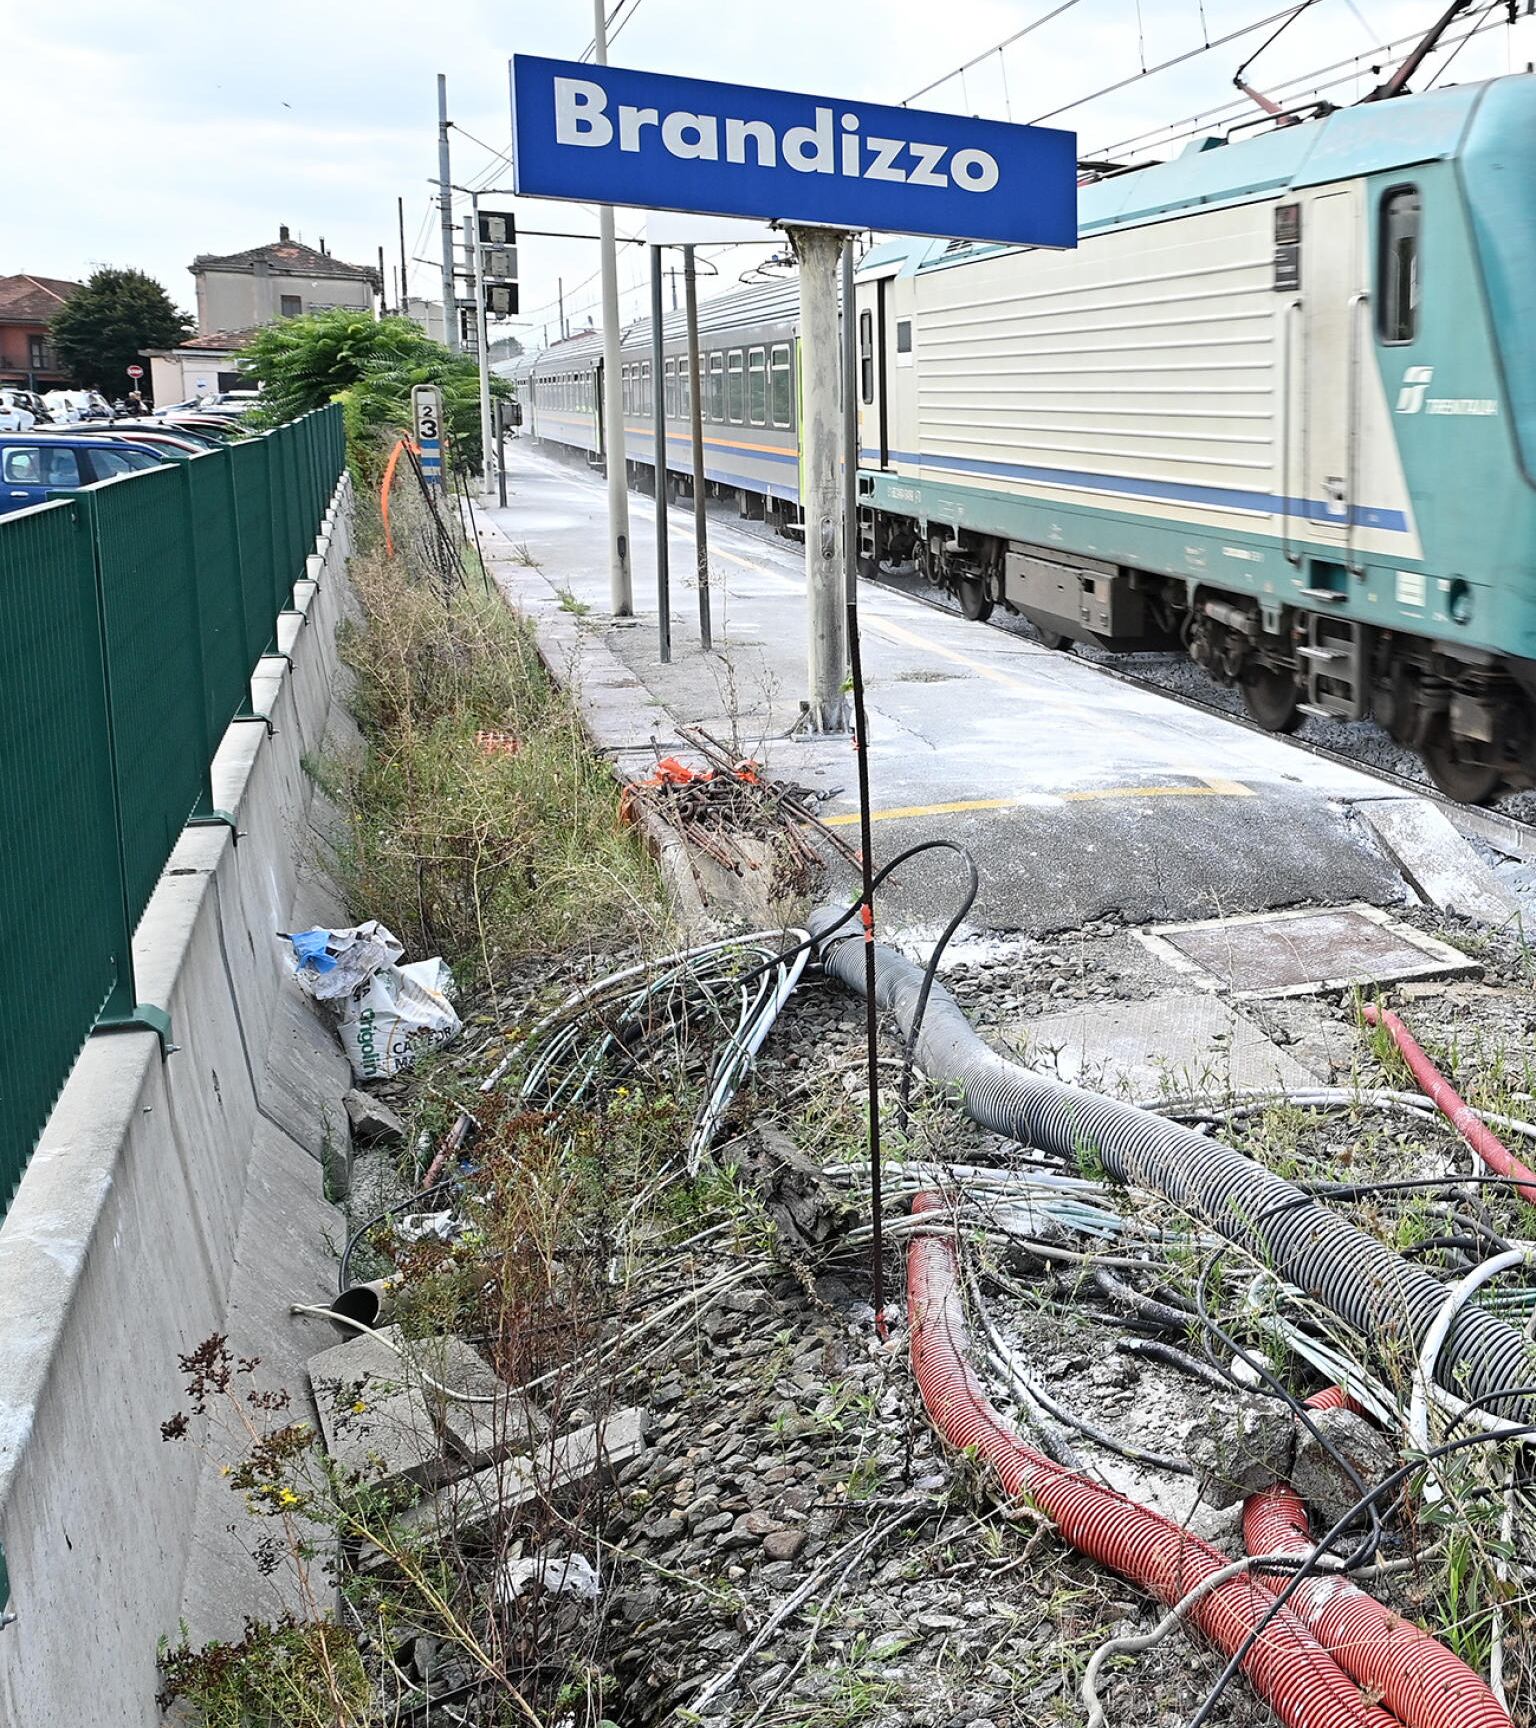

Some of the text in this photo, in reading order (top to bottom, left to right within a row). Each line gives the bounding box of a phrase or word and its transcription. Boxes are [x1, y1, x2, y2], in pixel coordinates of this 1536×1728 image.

[553, 76, 1000, 192] Brandizzo
[422, 405, 433, 417] 2
[420, 419, 437, 438] 3
